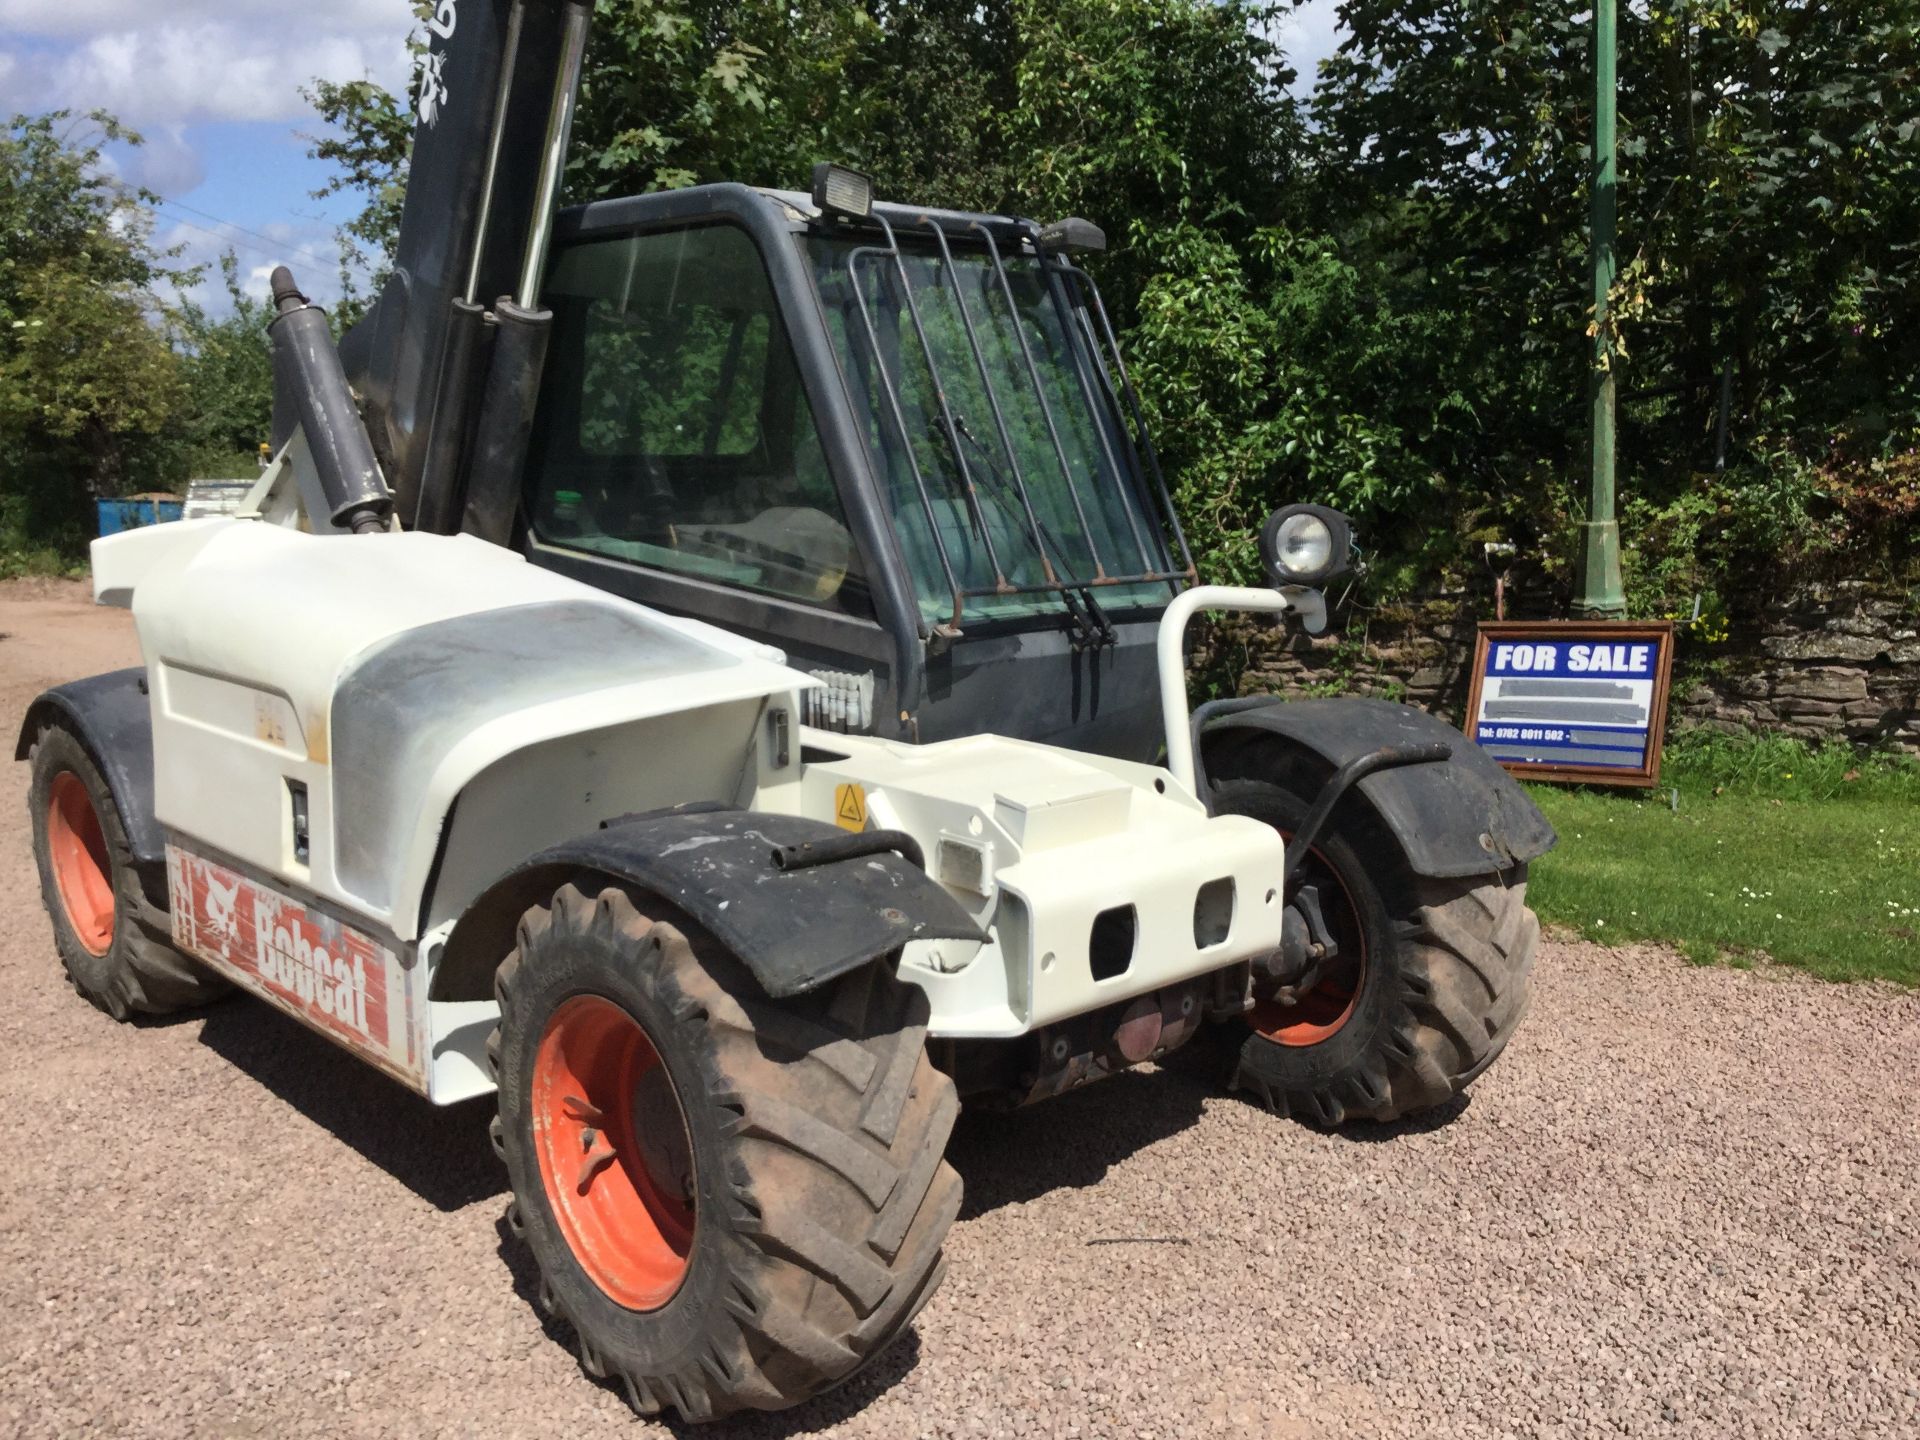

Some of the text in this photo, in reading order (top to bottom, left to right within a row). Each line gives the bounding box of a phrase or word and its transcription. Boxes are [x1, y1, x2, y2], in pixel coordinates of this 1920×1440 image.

[1495, 645, 1649, 672] FOR SALE
[1479, 727, 1495, 738] Tel:
[253, 898, 369, 1036] Bobcat
